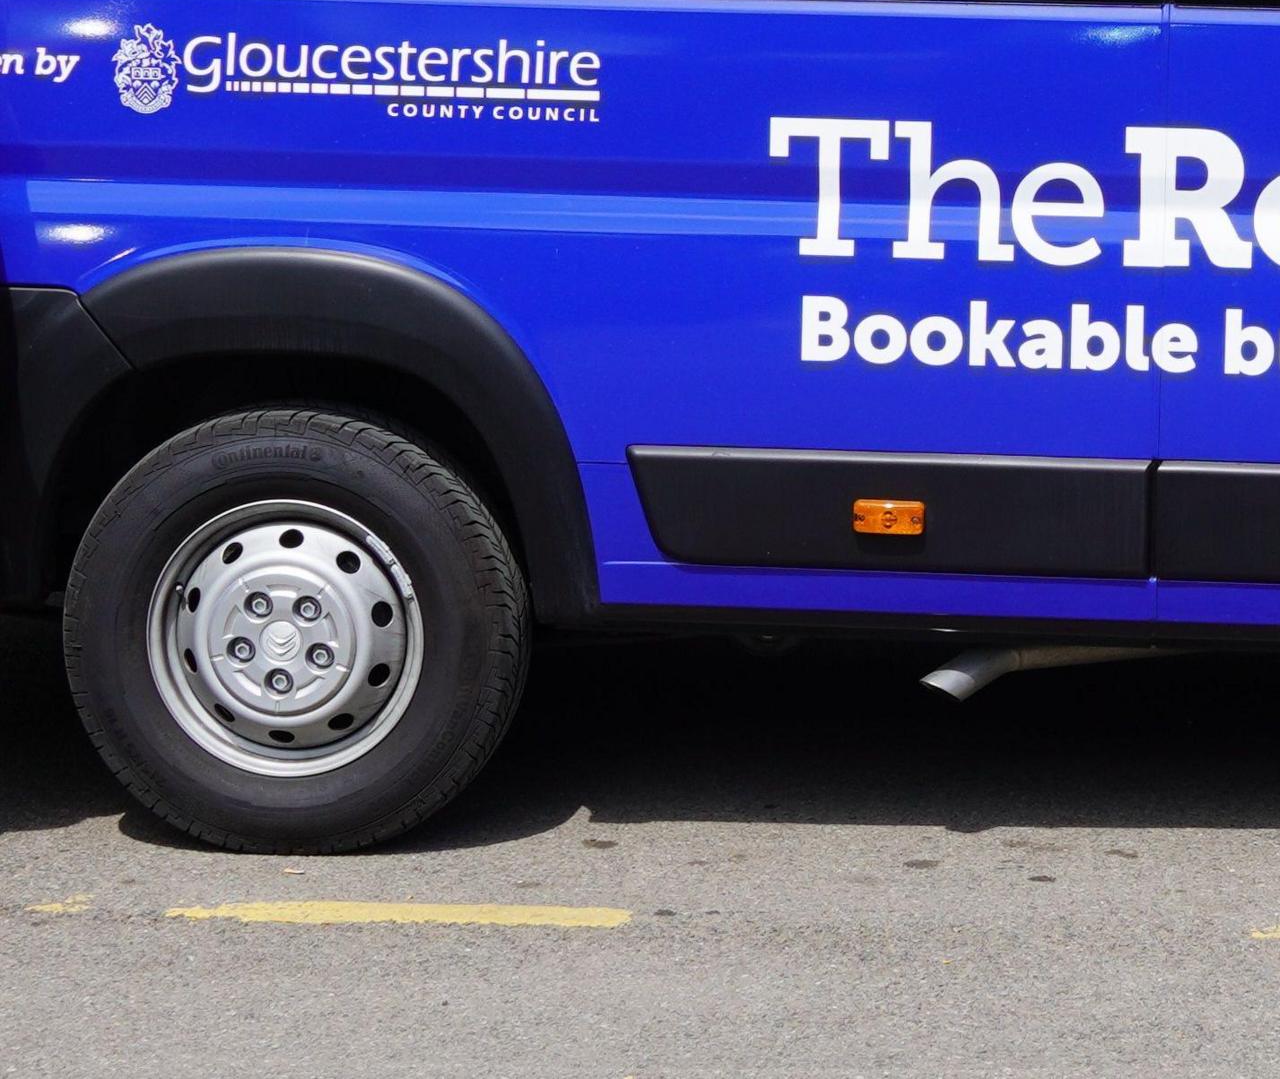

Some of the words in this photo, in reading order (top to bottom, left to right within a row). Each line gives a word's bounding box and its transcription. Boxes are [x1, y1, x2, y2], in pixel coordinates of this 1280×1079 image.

[34, 47, 81, 83] by
[183, 32, 601, 92] Gloucestershire
[387, 103, 484, 120] COUNTY
[492, 105, 600, 122] COUNCIL
[769, 116, 1105, 267] The
[800, 295, 1198, 374] Bookable
